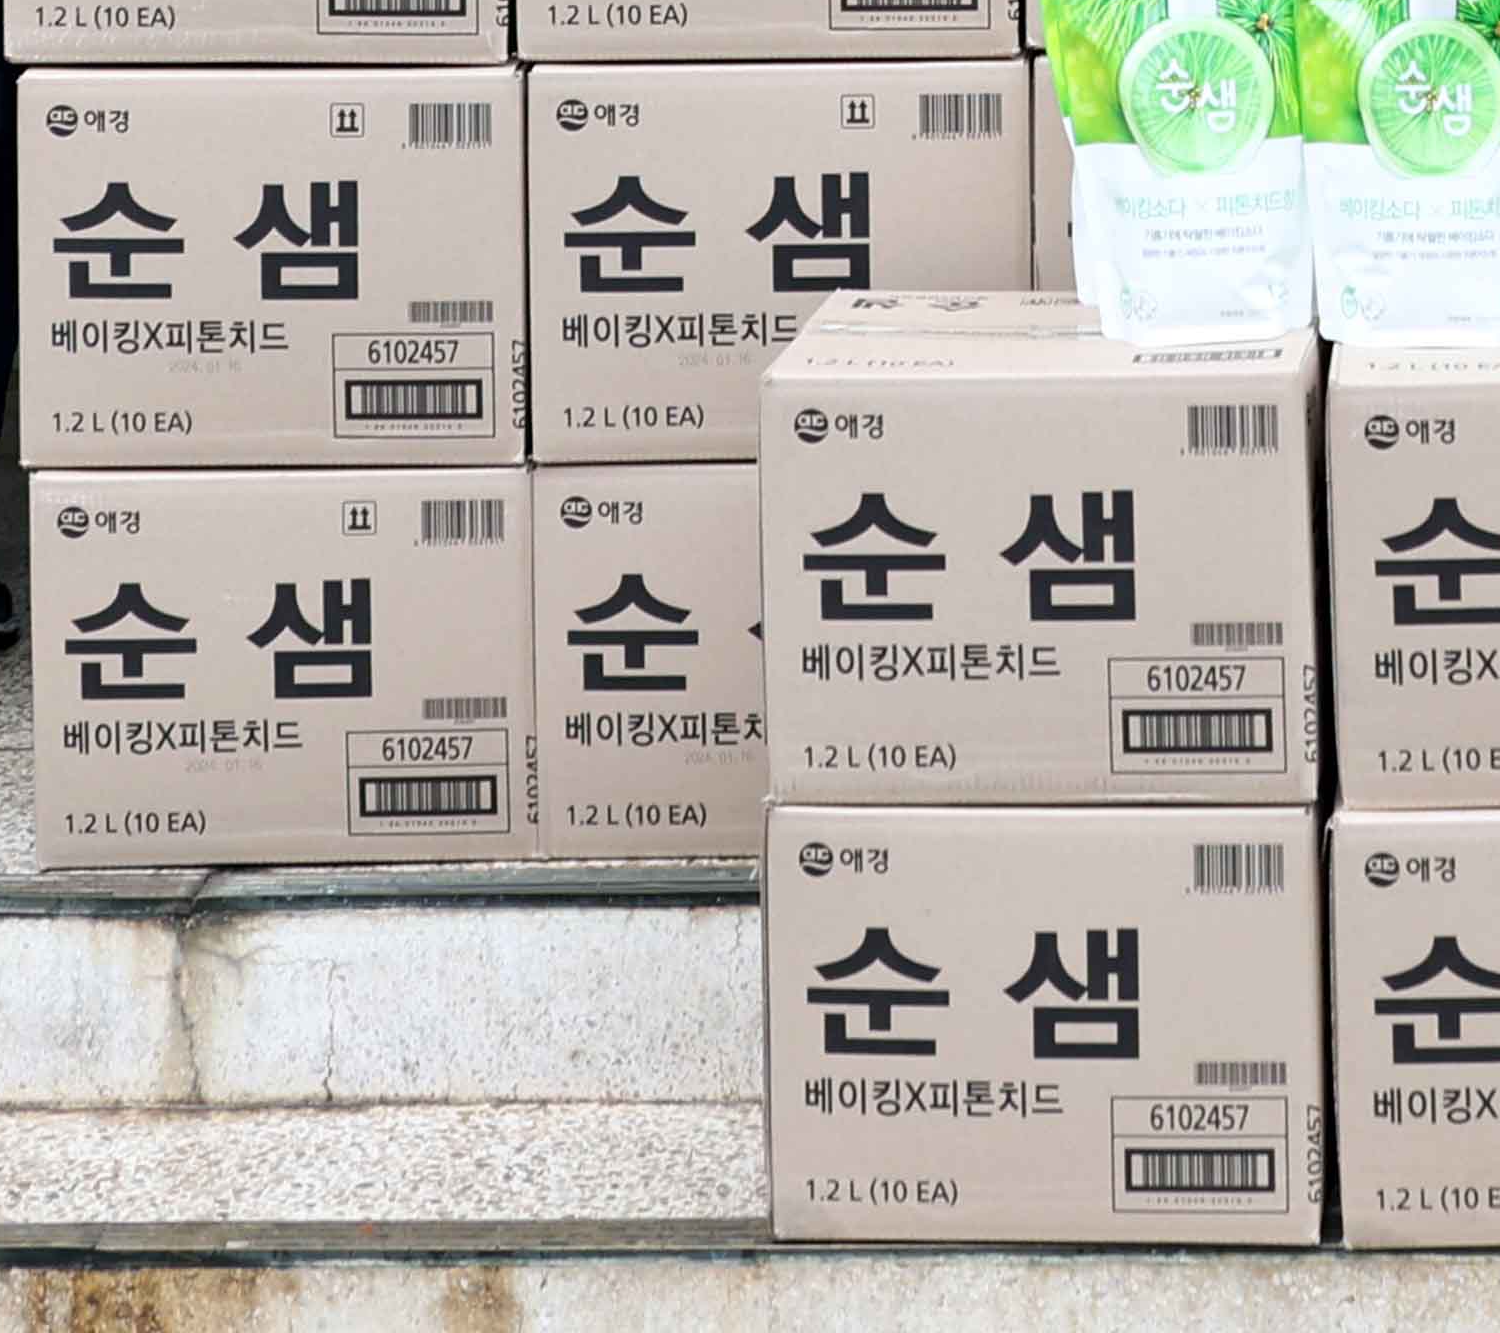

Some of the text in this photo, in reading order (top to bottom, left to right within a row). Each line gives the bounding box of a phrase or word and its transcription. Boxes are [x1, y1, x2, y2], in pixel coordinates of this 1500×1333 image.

[83, 107, 131, 136] 애경
[51, 316, 290, 357] 베이킹X피톤치드
[366, 335, 460, 366] 6102457
[834, 410, 886, 442] 애경
[1405, 415, 1458, 448] 애경
[597, 498, 645, 527] 애경
[801, 640, 1062, 685] 베이킹X피톤치드
[1144, 660, 1247, 694] 6102457
[63, 715, 304, 759] 베이킹X피톤치드
[380, 731, 474, 763] 6102457
[839, 845, 891, 877] 애경
[1405, 853, 1458, 886] 애경
[804, 1076, 1065, 1120] 베이킹X피톤치드
